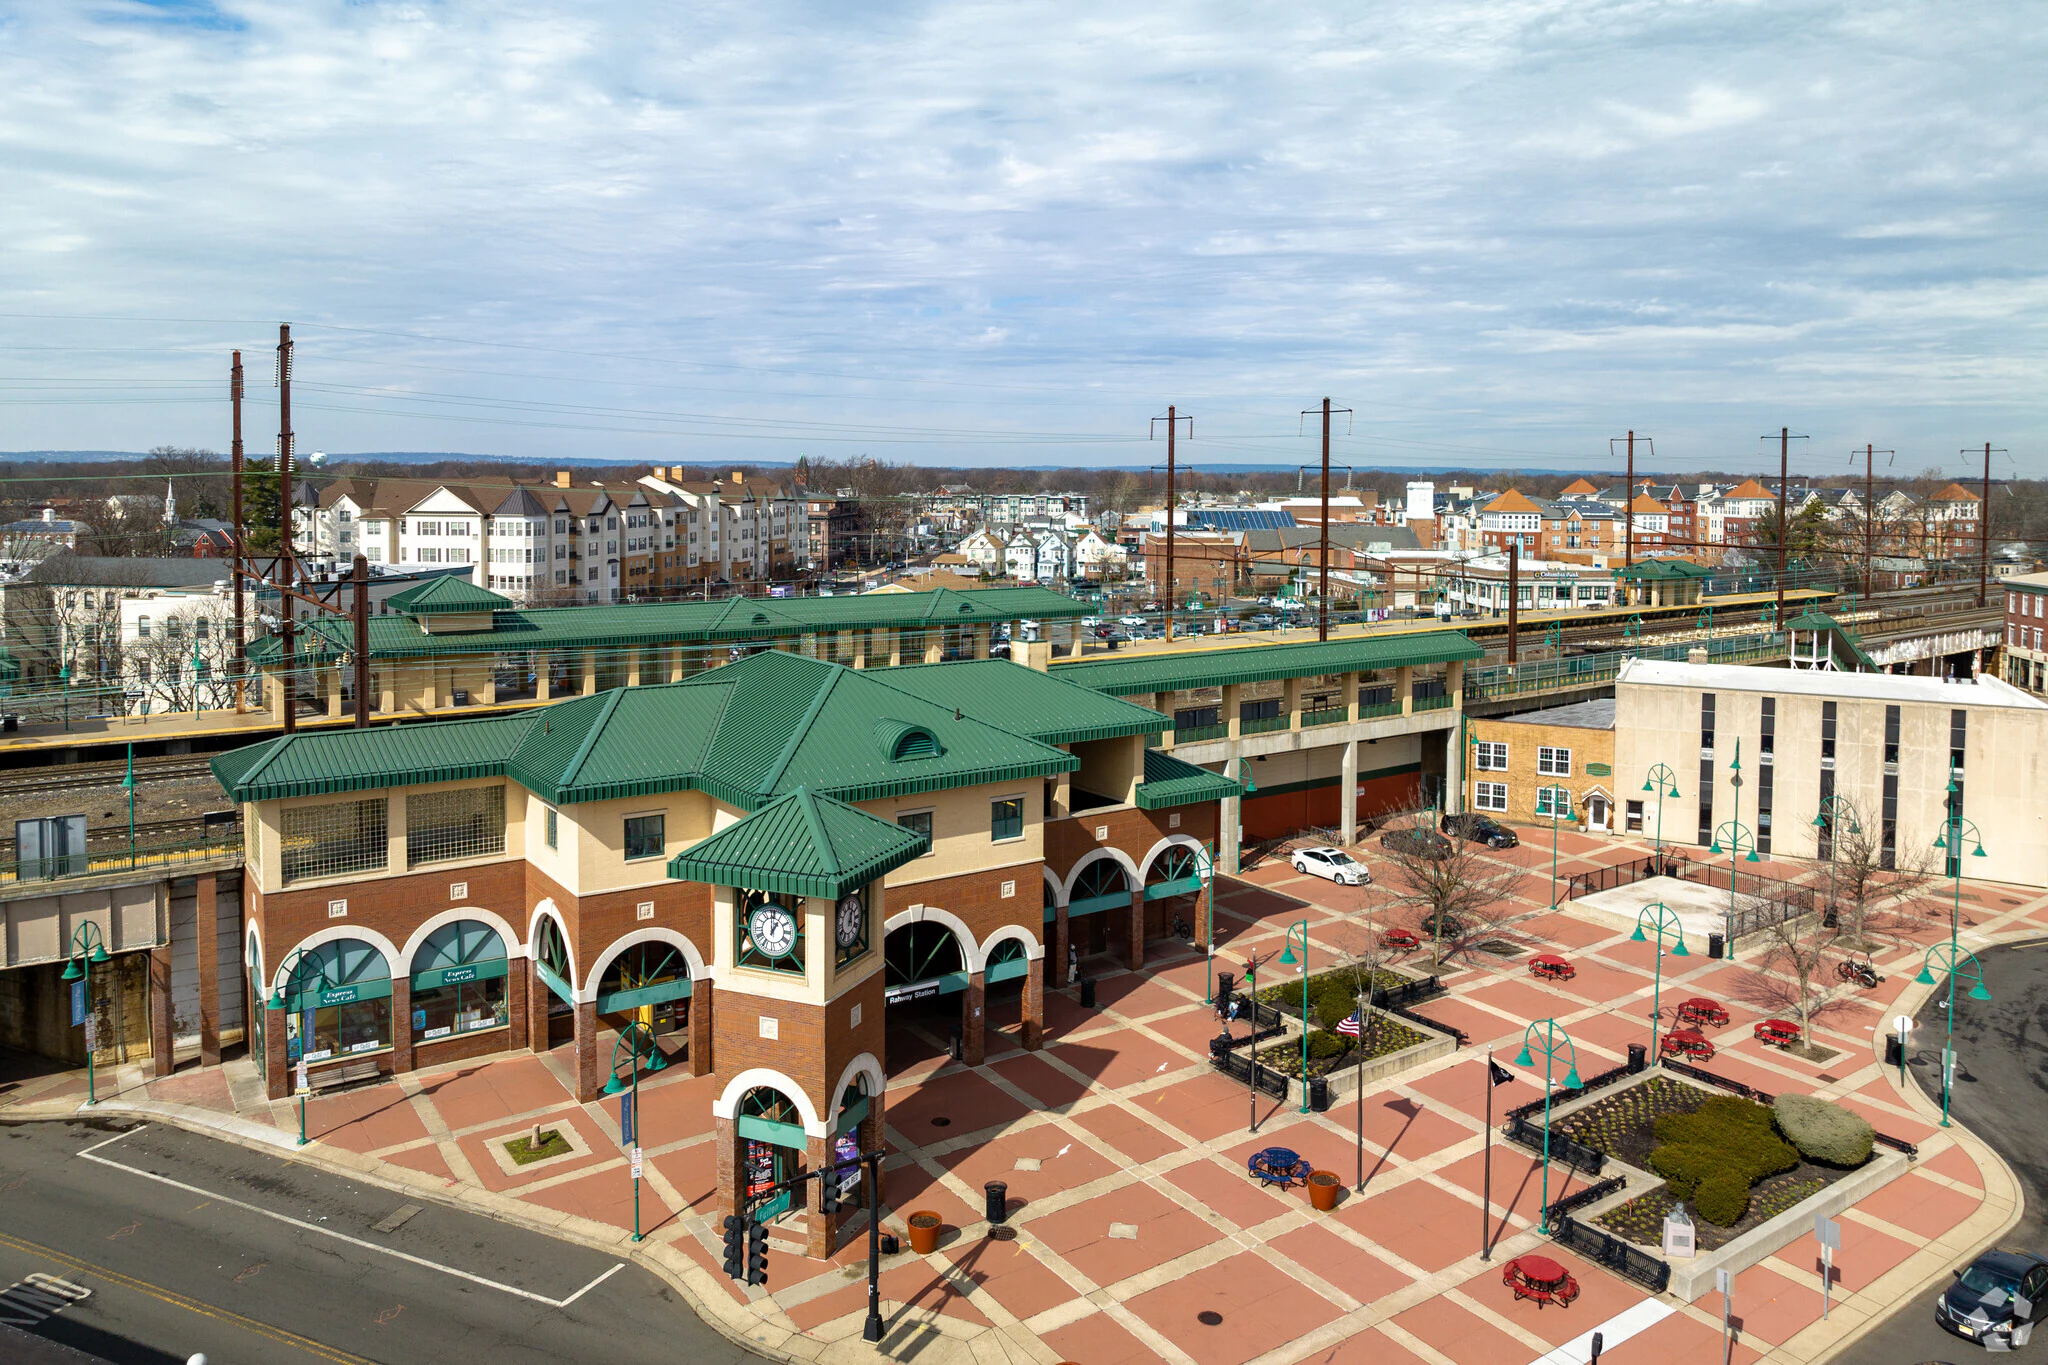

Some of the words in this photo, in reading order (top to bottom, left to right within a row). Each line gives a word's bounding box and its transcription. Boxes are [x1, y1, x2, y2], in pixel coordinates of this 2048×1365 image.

[447, 969, 472, 977] Express
[326, 990, 353, 998] Express
[889, 994, 913, 1004] Rahway
[915, 989, 936, 998] Station
[851, 1173, 859, 1184] RED
[759, 1203, 779, 1219] Fulton
